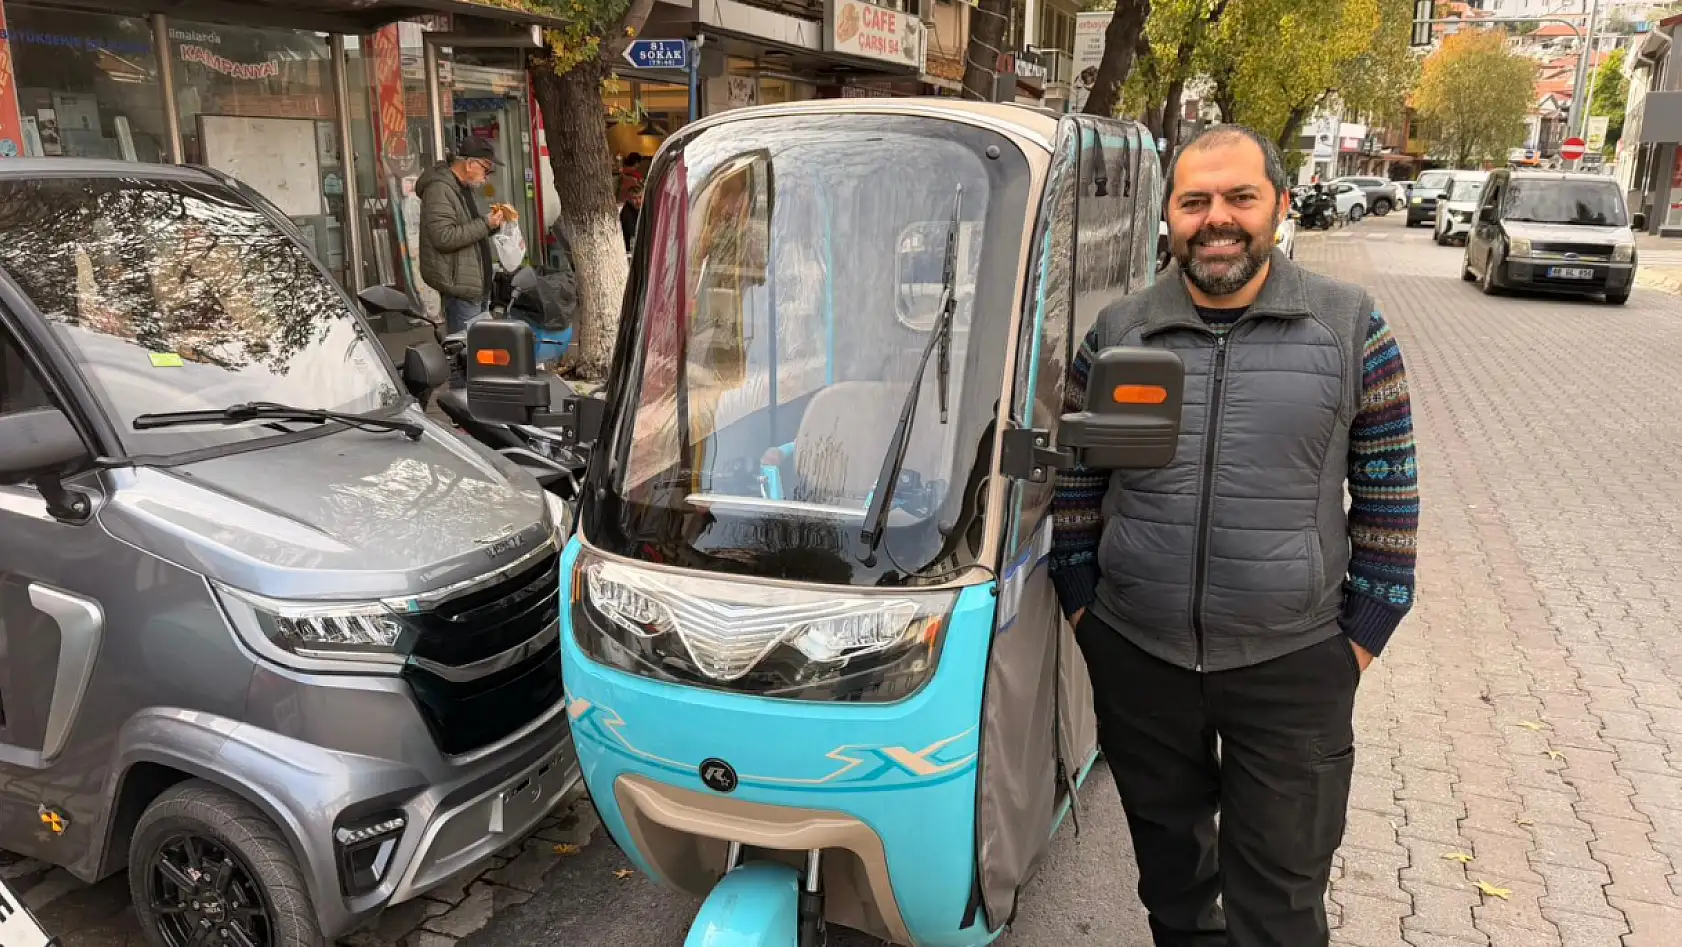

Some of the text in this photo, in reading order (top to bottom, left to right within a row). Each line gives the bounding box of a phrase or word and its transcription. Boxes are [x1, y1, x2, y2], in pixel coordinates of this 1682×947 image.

[862, 6, 896, 34] CAFE
[639, 50, 682, 60] SOKAK
[858, 31, 886, 56] ÇARŞI
[180, 43, 279, 79] KAMPANYA!
